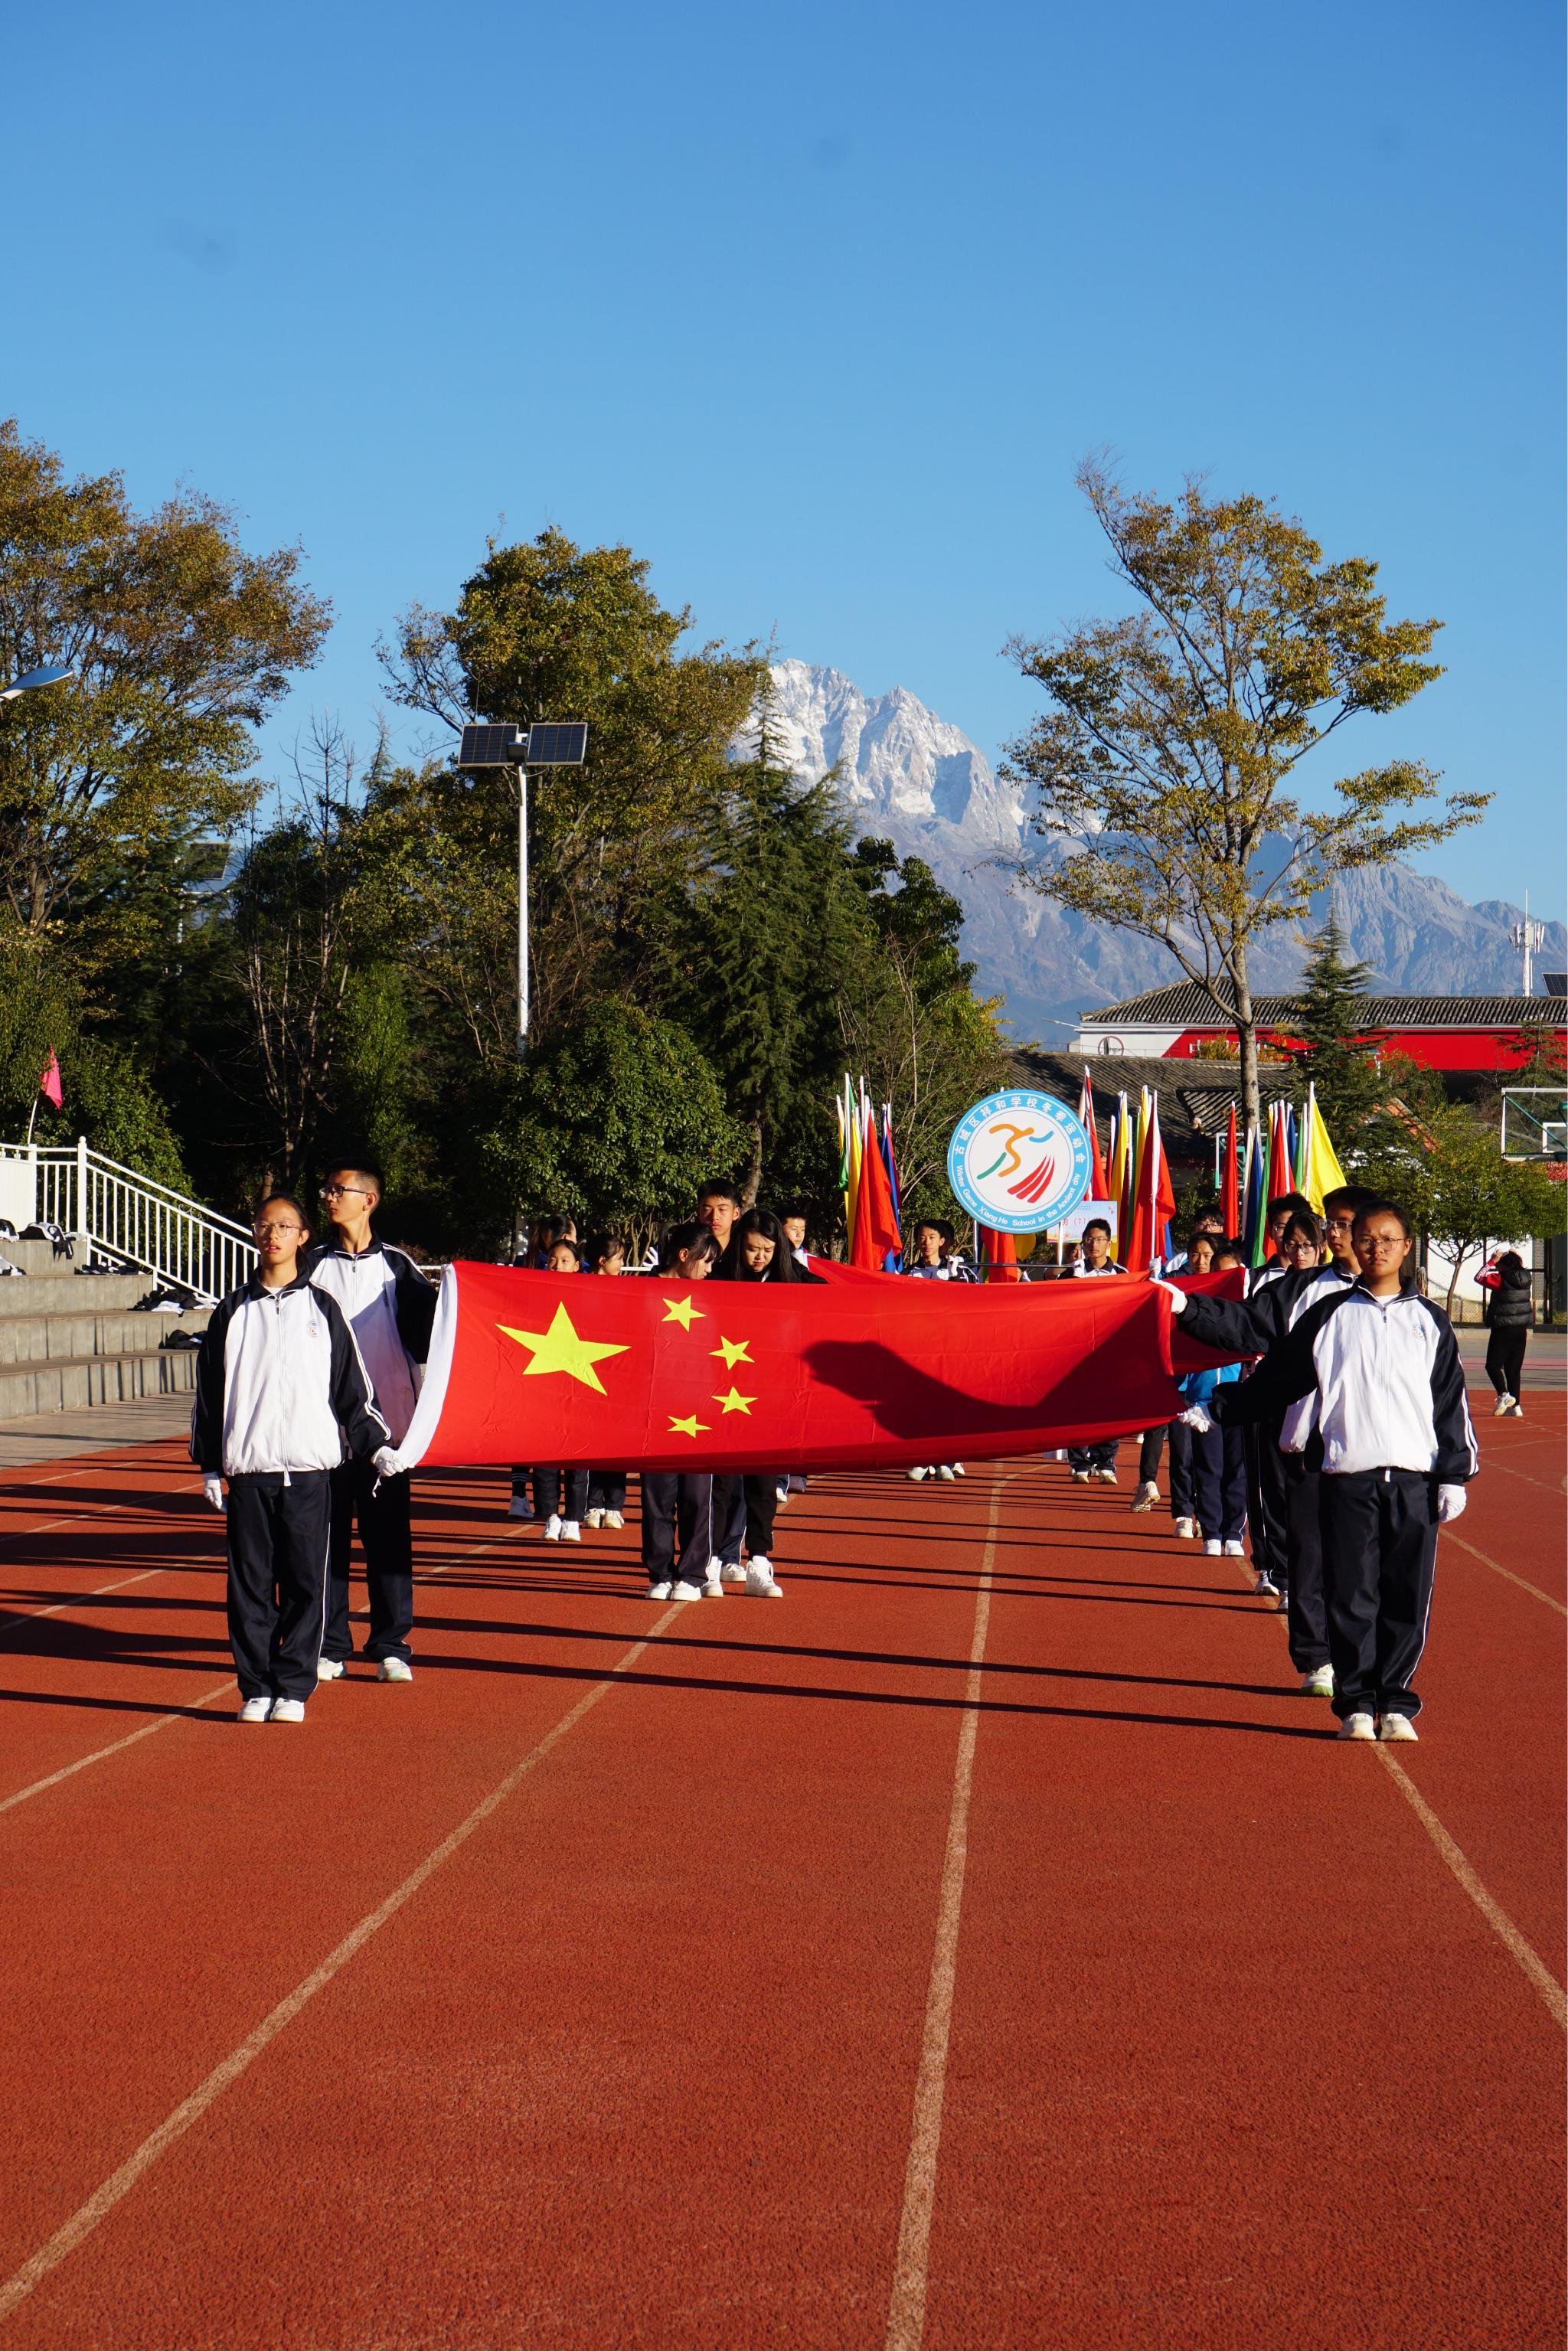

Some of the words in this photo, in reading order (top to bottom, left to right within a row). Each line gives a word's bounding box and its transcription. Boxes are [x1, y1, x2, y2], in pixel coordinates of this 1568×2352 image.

[954, 1096, 1086, 1163] 古城区祥和学校冬季运动会
[956, 1165, 965, 1187] Winter
[962, 1188, 978, 1207] Game
[978, 1206, 998, 1222] Xiang
[998, 1217, 1008, 1225] He
[1012, 1218, 1036, 1227] School
[1046, 1209, 1058, 1219] the
[1057, 1187, 1076, 1210] Ancient
[1072, 1172, 1081, 1186] city
